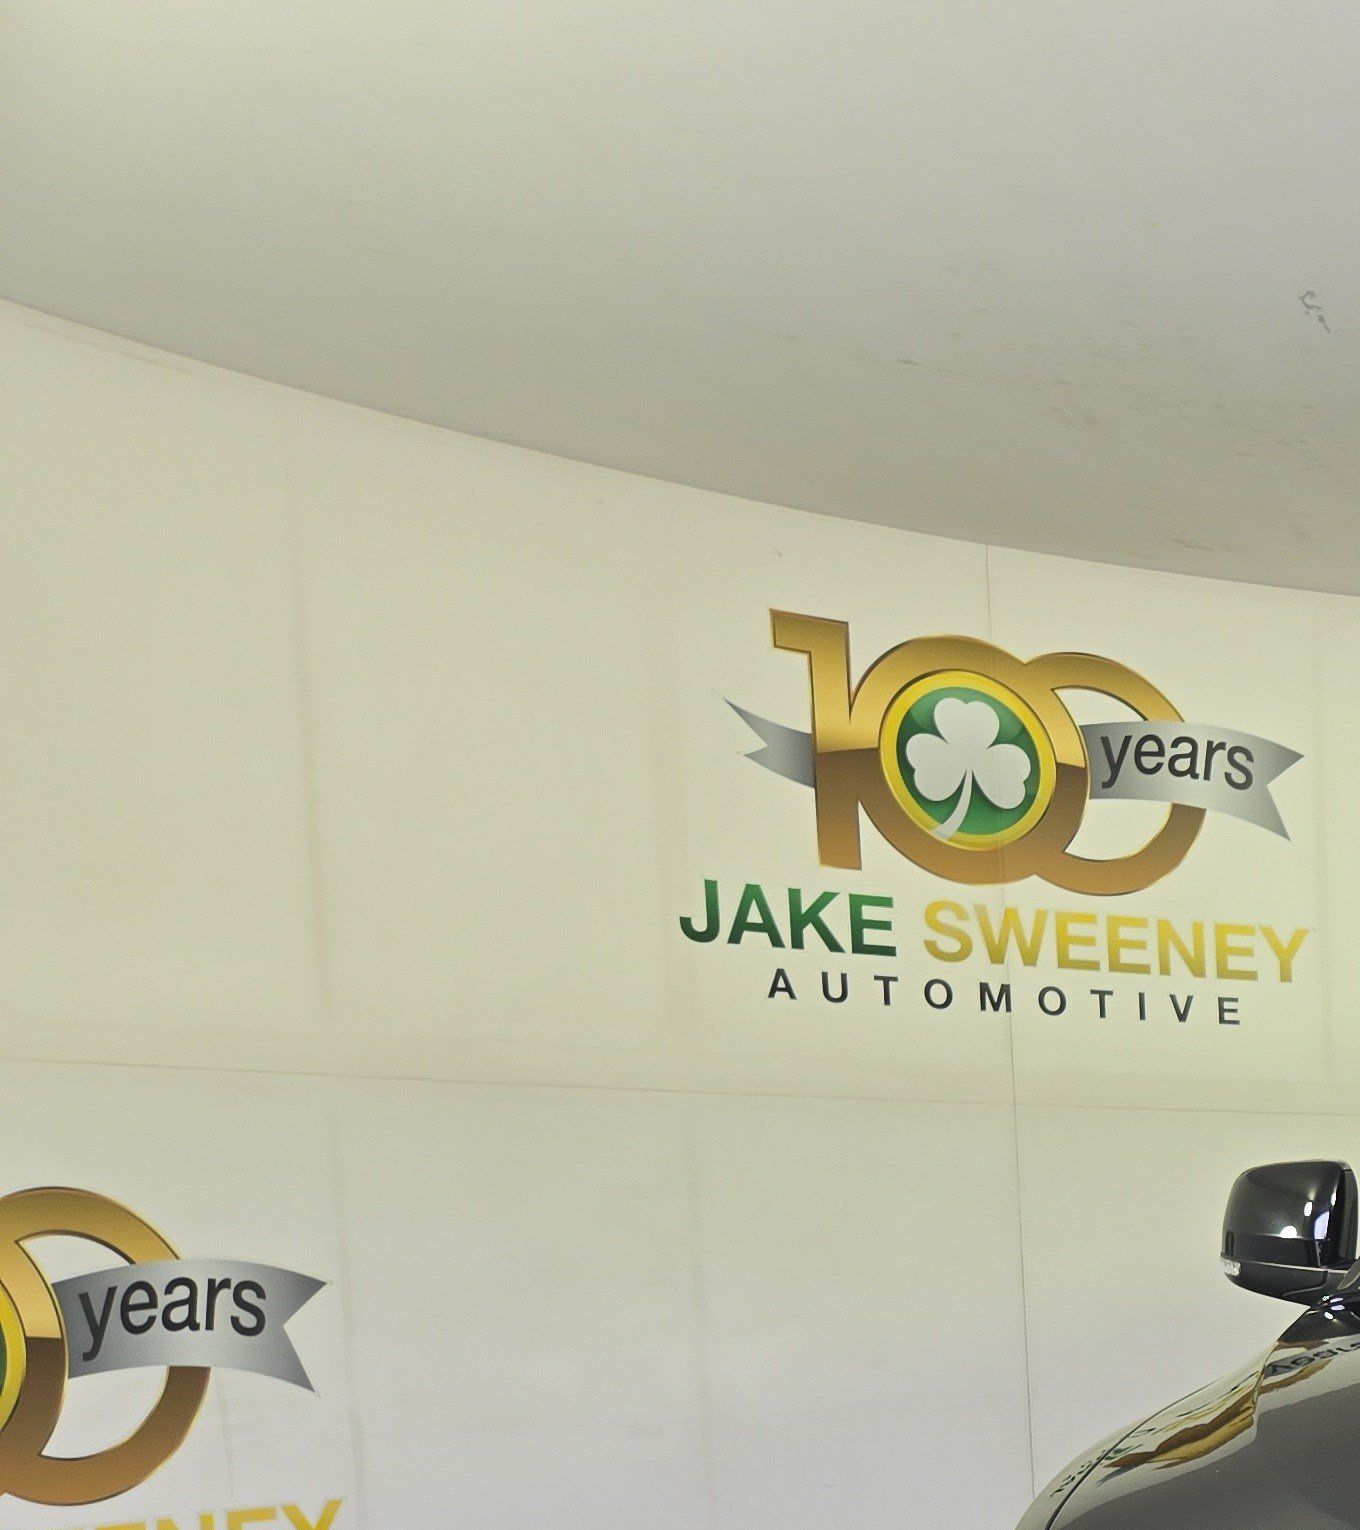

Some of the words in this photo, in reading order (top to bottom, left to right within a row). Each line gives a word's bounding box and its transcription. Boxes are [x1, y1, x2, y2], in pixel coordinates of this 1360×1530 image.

[769, 608, 1207, 896] 100
[1100, 732, 1255, 791] years
[679, 879, 898, 958] JAKE
[922, 900, 1310, 984] SWEENEY
[768, 968, 1242, 1026] AUTOMOTIVE
[78, 1275, 267, 1362] years
